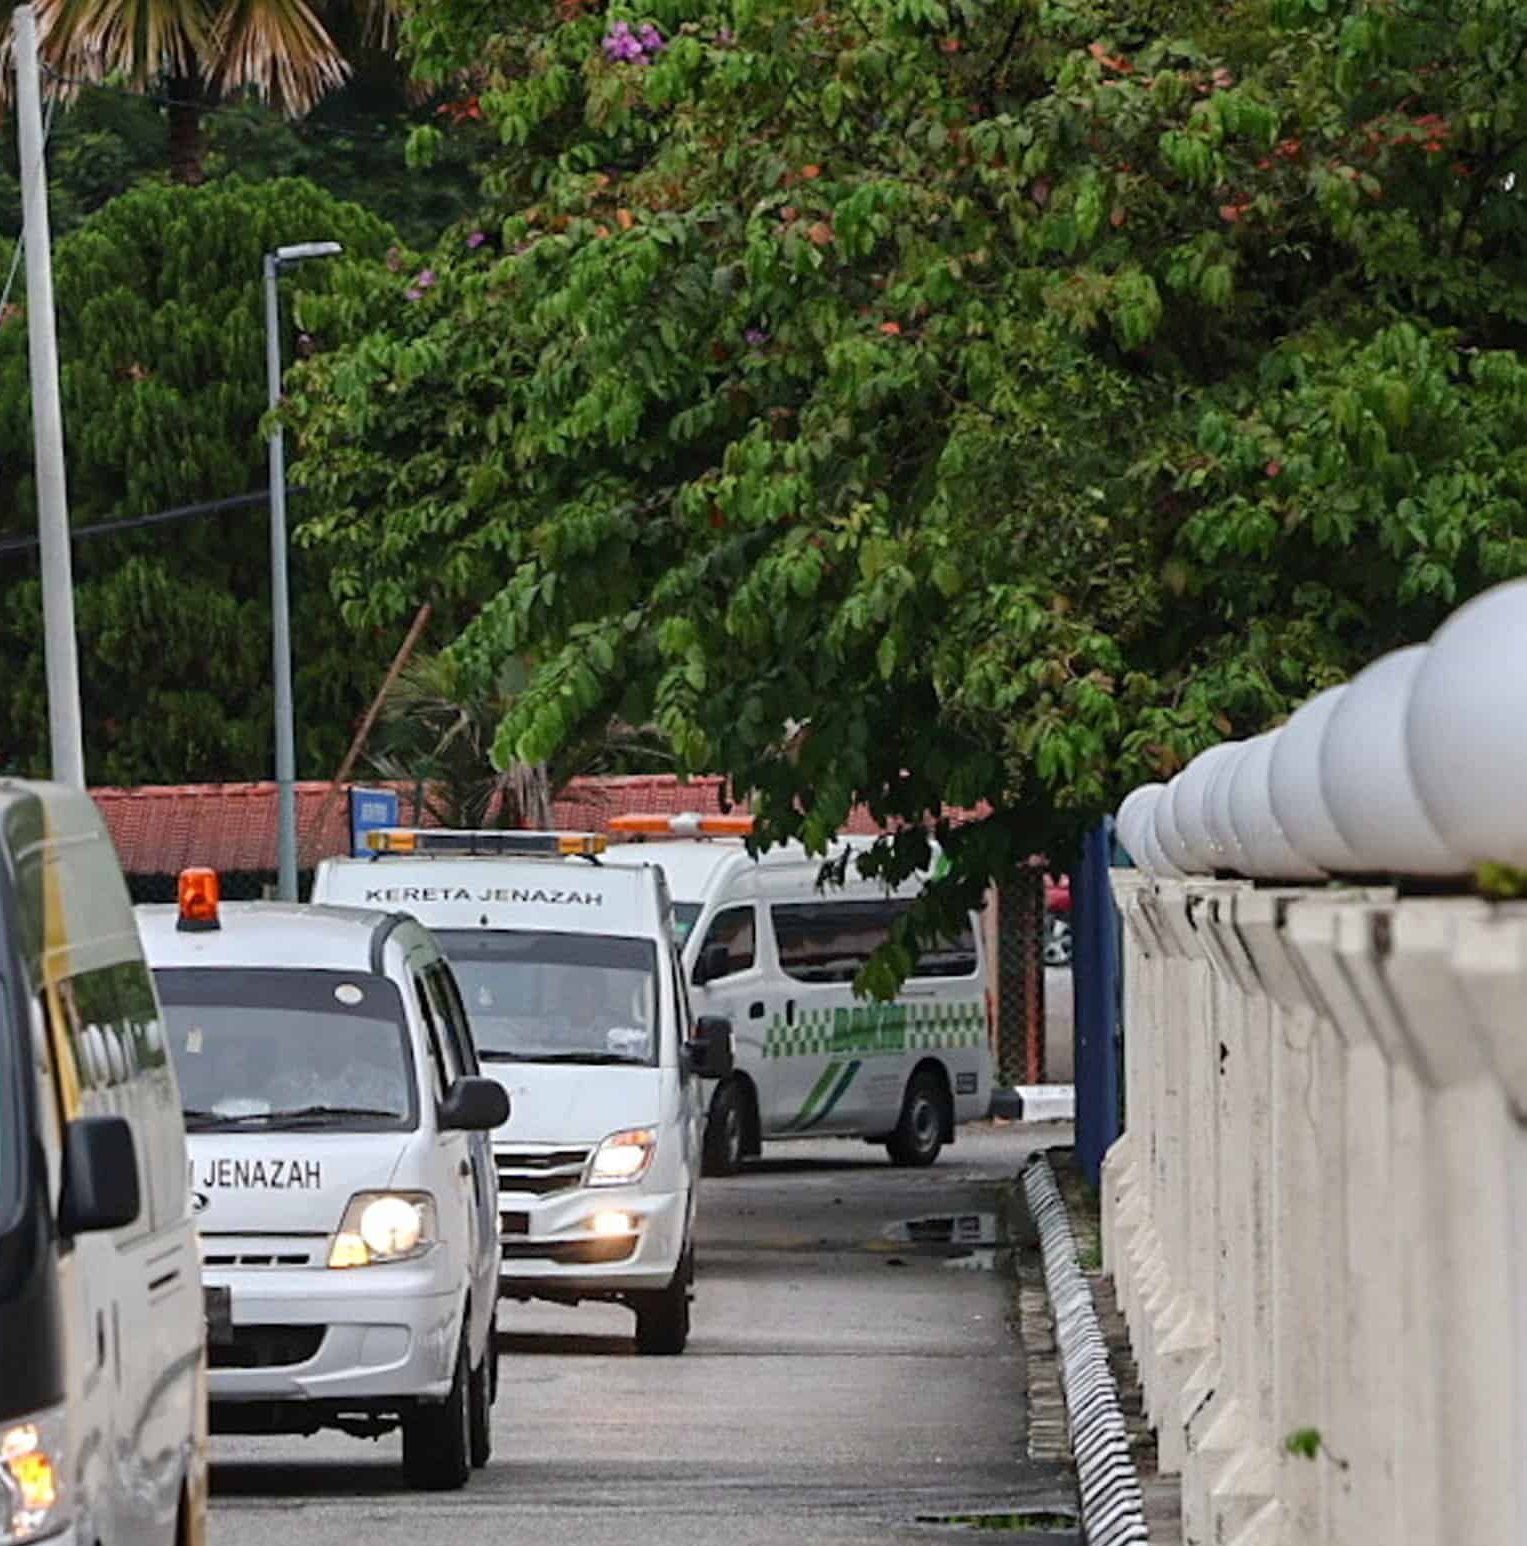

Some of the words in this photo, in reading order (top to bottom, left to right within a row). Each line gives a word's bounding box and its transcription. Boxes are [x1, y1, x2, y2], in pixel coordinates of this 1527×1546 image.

[365, 887, 471, 902] KERETA
[477, 888, 603, 906] JENAZAH
[203, 1159, 321, 1189] JENAZAH
